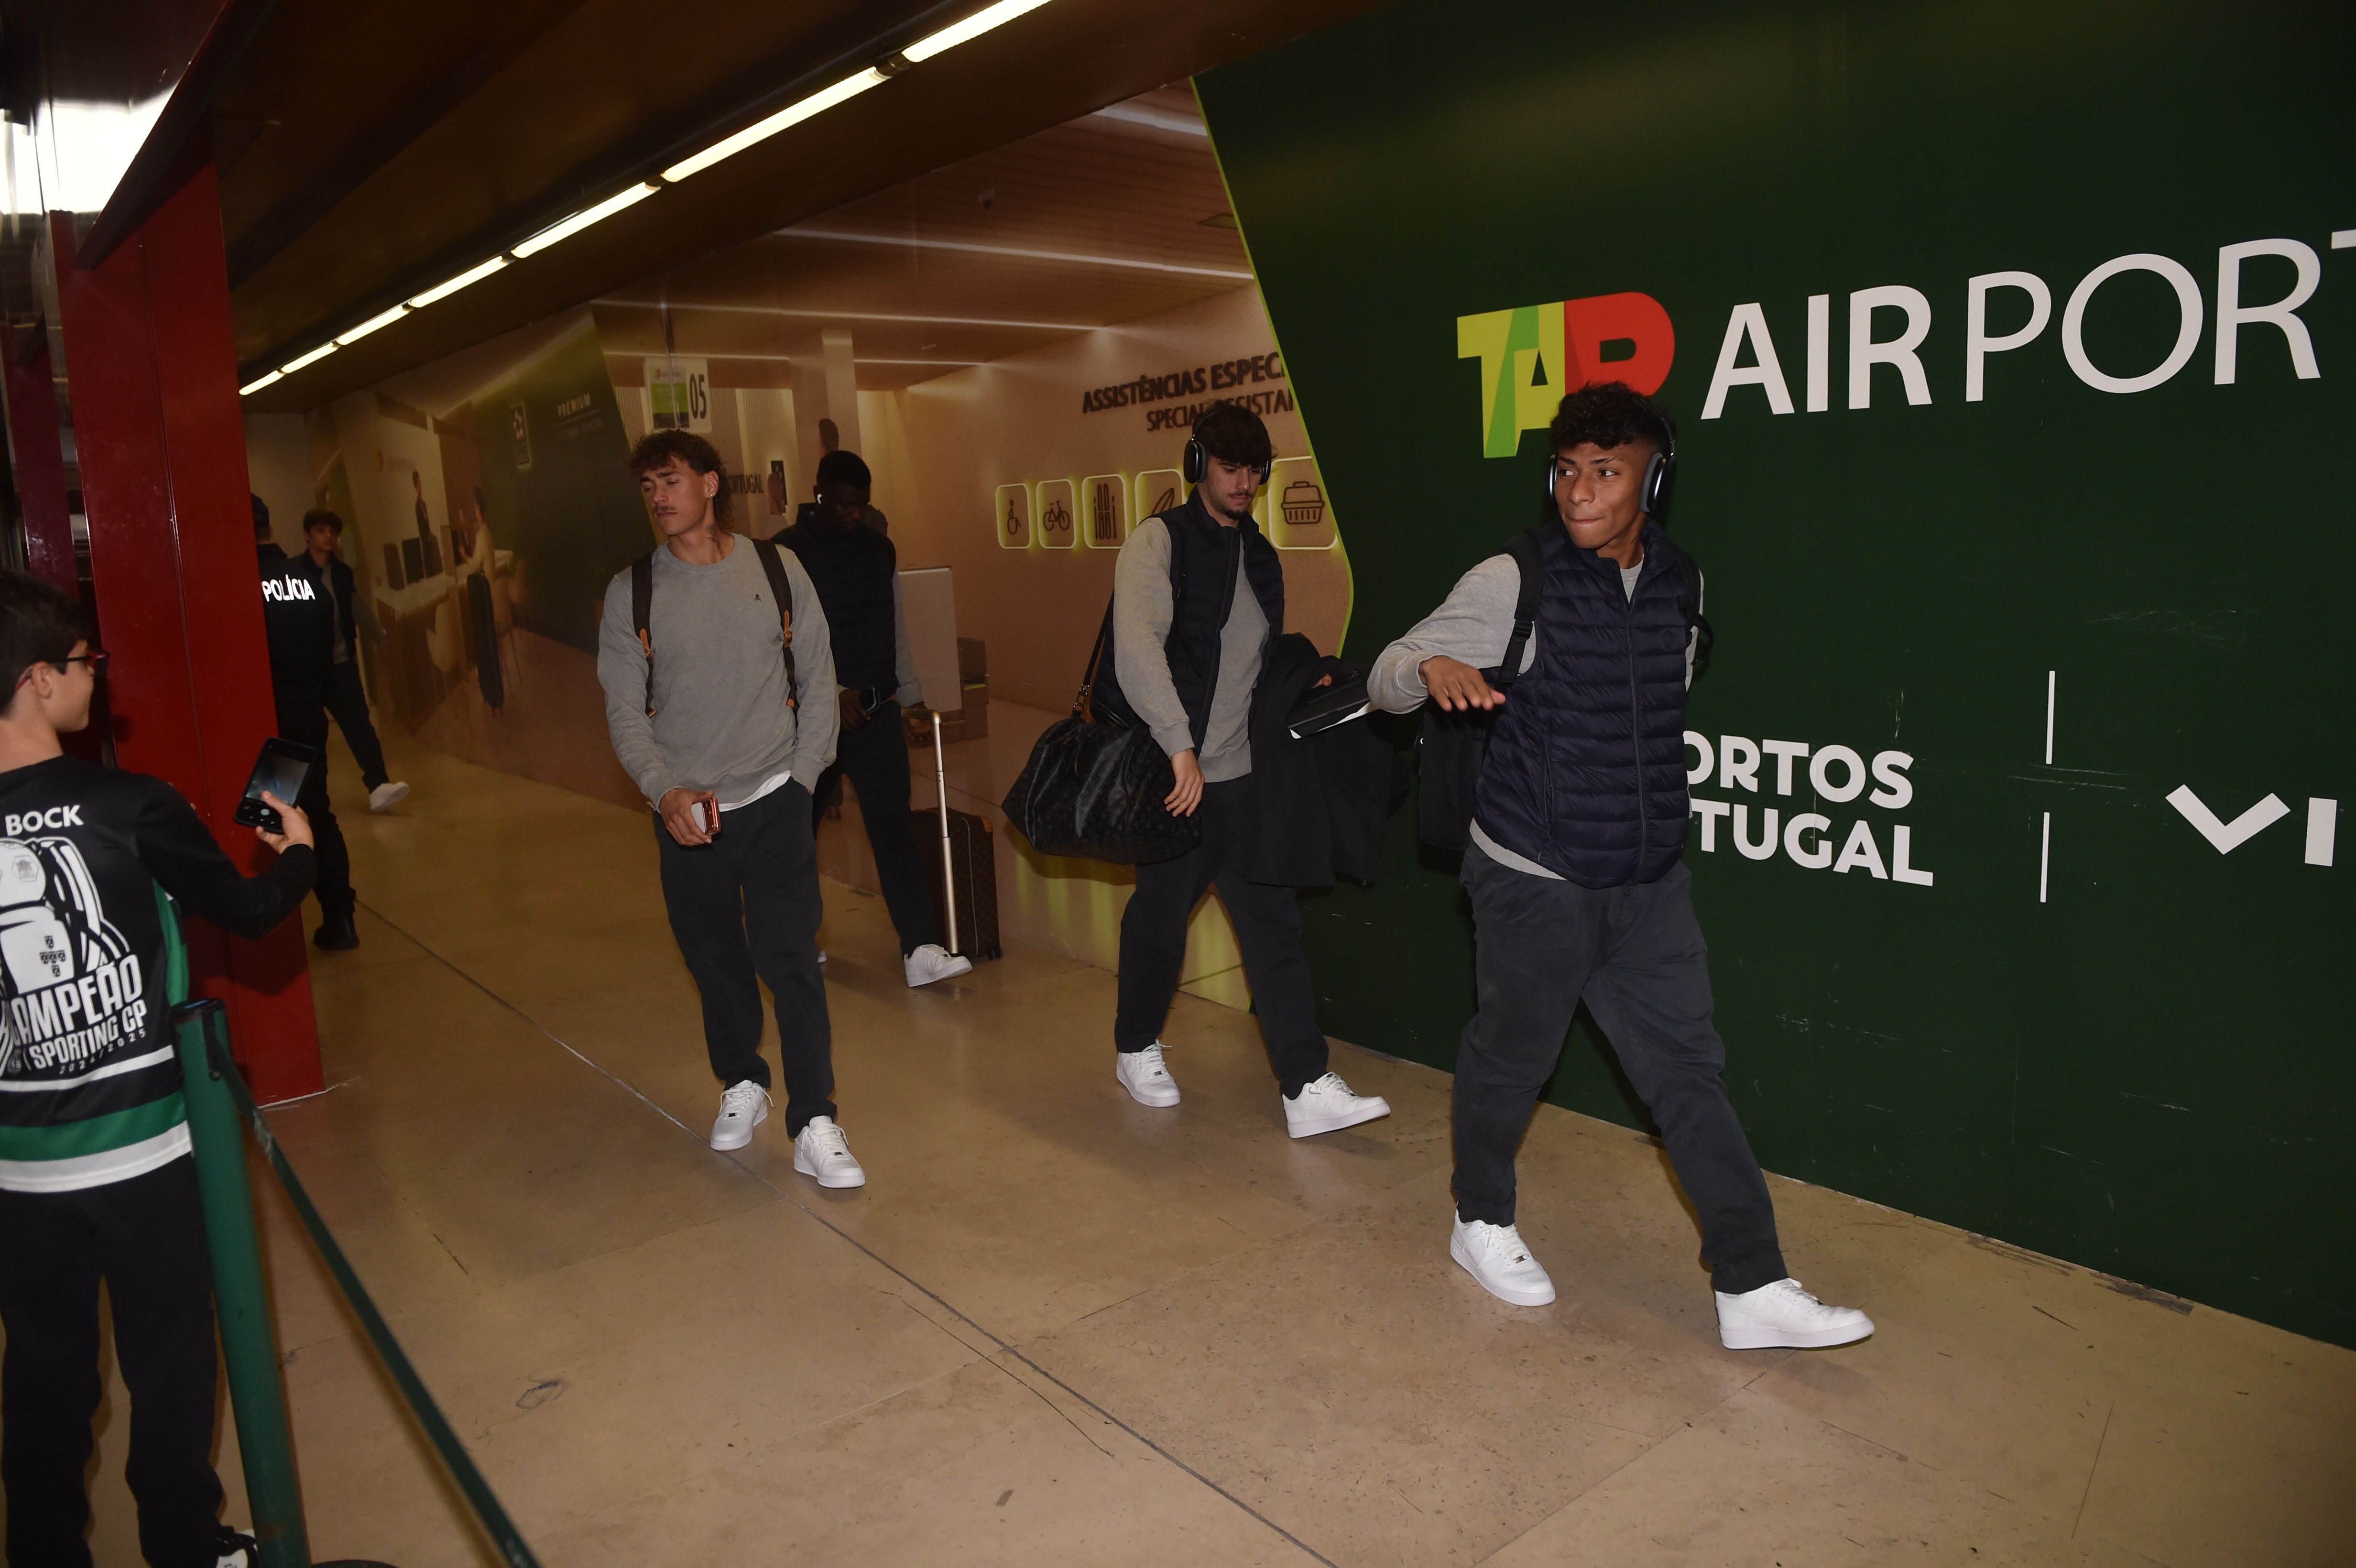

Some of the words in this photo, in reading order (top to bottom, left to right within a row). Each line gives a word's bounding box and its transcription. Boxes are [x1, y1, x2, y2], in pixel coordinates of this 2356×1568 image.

[1457, 291, 1675, 458] TAP
[1966, 230, 2356, 402] POR
[689, 373, 707, 419] 05
[1082, 367, 1206, 413] ASSISTÊNCIAS
[262, 574, 316, 602] POLÍCIA
[5, 805, 84, 836] BOCK
[29, 1015, 120, 1069] SPORTING
[121, 999, 147, 1033] CP
[59, 1028, 146, 1075] 2024/2025
